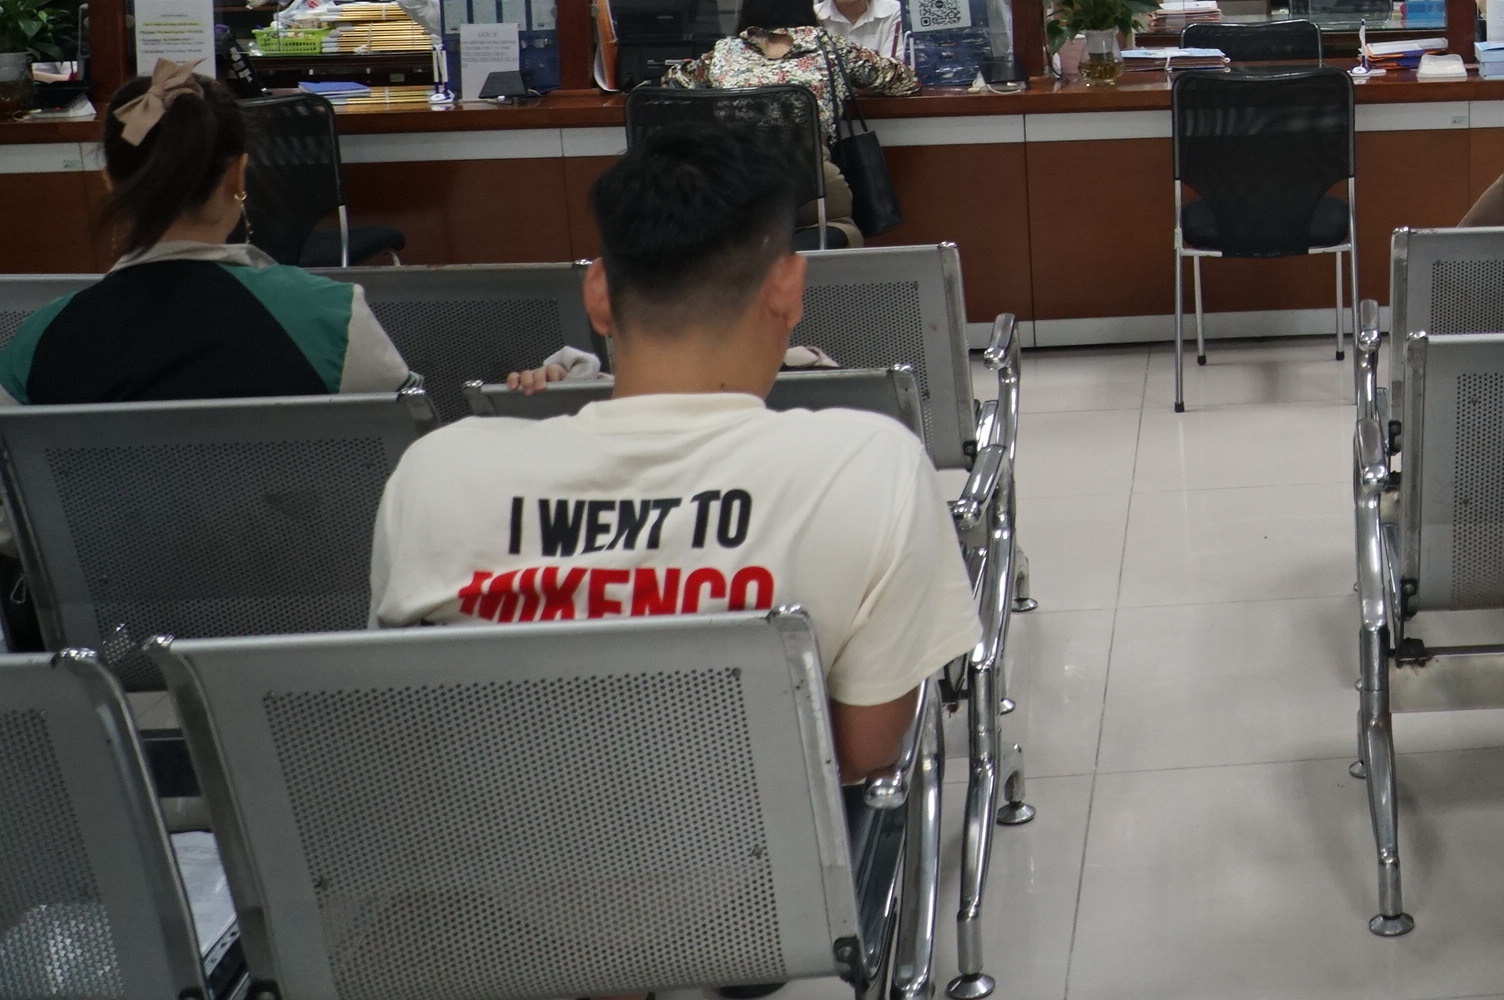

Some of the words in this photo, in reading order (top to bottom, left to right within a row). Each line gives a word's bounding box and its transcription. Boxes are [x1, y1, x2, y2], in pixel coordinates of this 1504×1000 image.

[508, 496, 524, 555] I
[538, 497, 682, 557] WENT
[690, 488, 752, 549] TO
